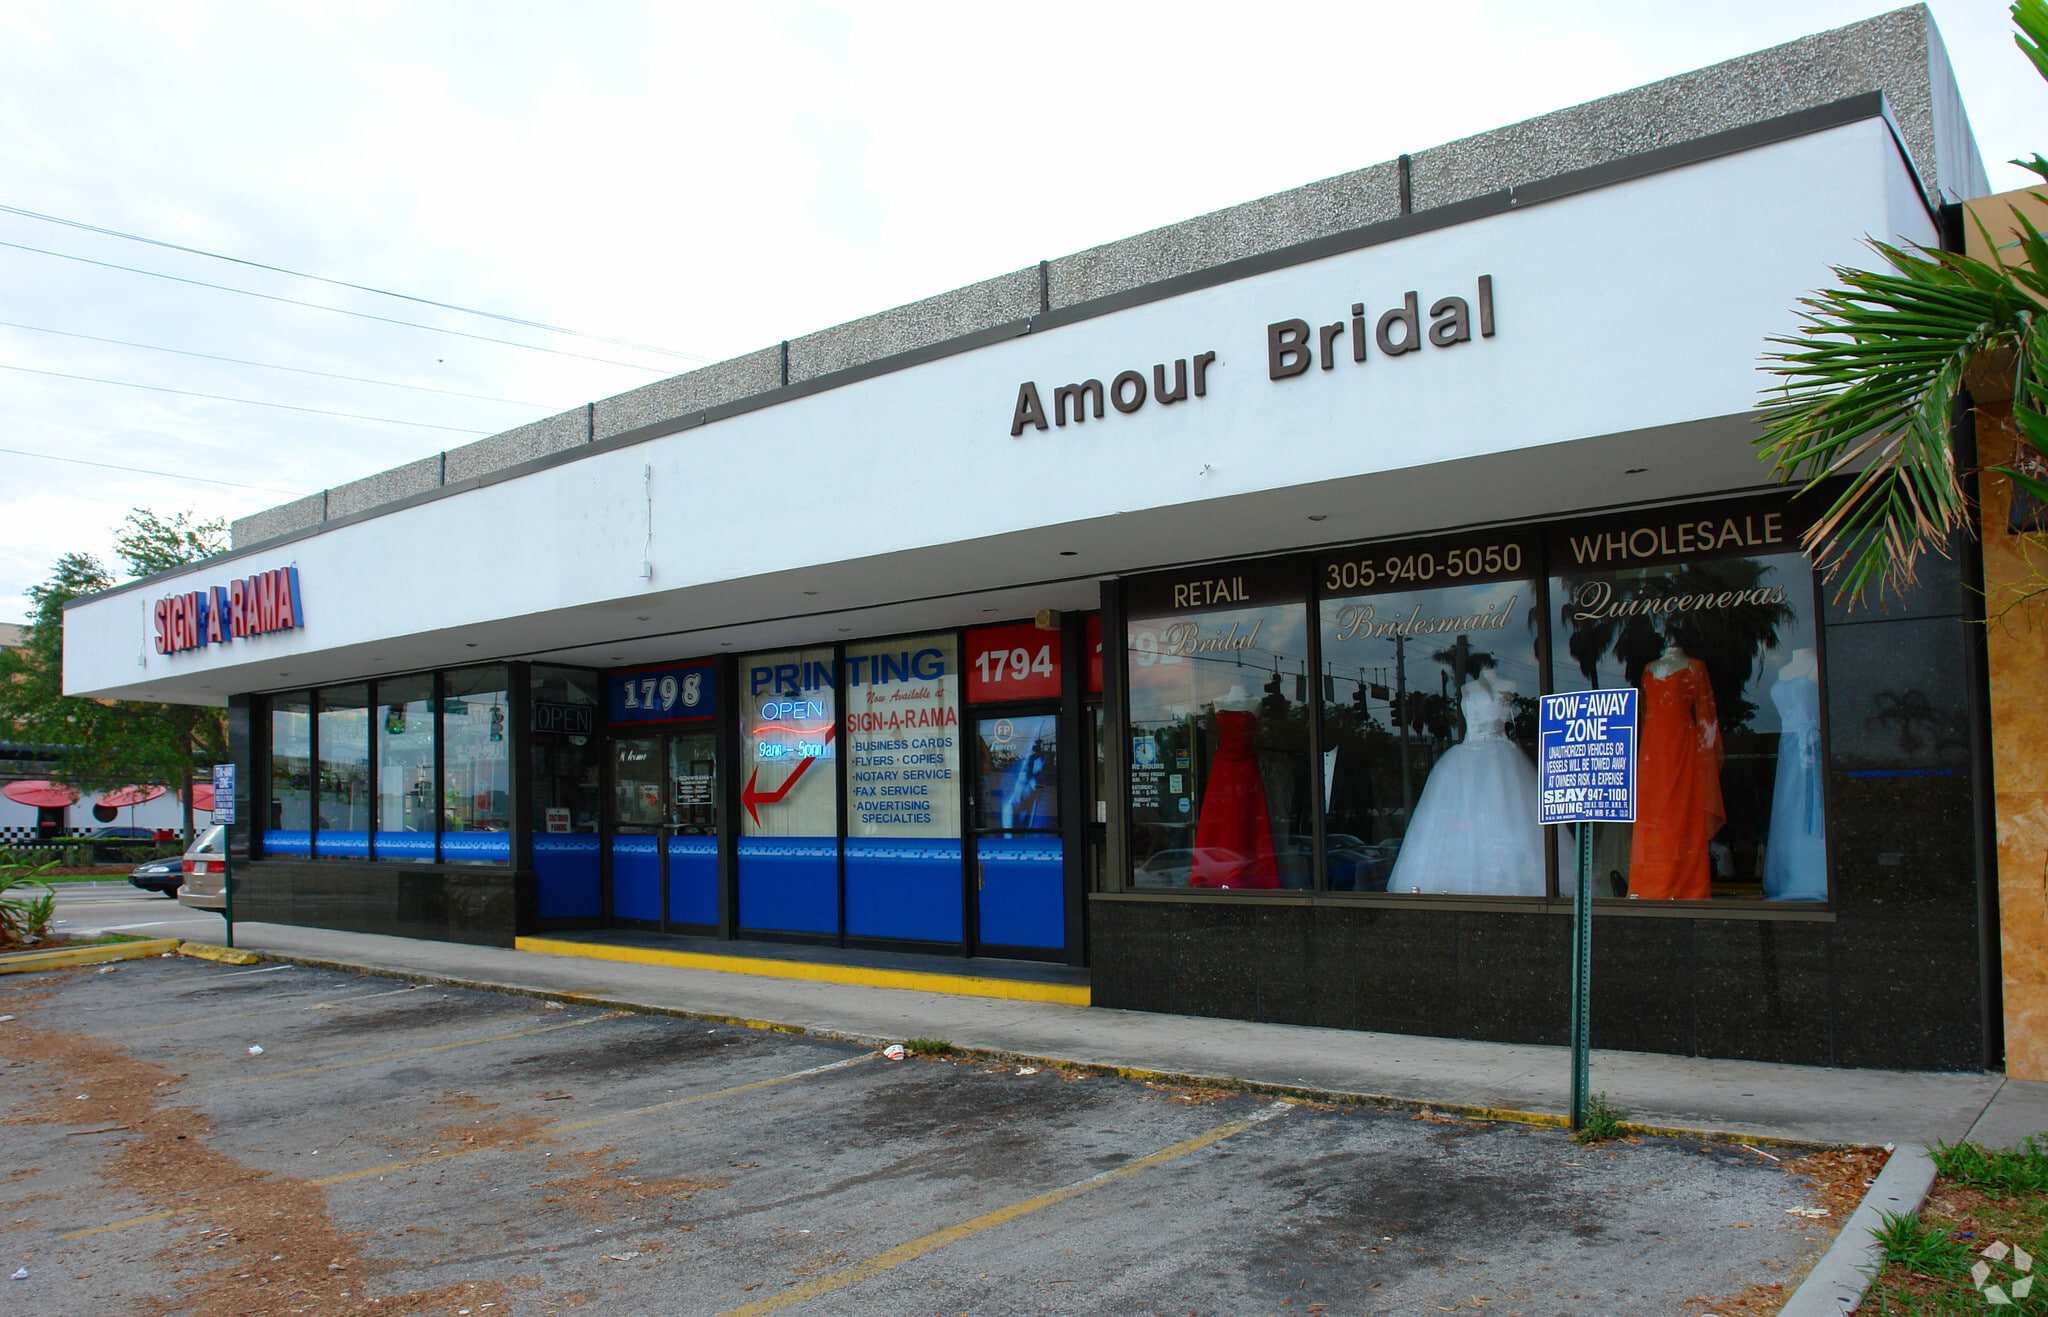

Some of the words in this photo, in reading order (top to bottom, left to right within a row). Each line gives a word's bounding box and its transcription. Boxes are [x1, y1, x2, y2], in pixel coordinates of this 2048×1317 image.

[1010, 350, 1216, 437] Amour
[1267, 274, 1496, 380] Bridal
[1570, 512, 1783, 564] WHOLESALE
[1326, 543, 1522, 590] 305-940-5050
[1174, 576, 1250, 608] RETAIL
[1574, 581, 1787, 621] Quinceneras
[1336, 595, 1518, 641] Bridesmaid
[1165, 619, 1264, 656] Bridal
[751, 648, 945, 696] PRINTING
[975, 645, 1053, 683] 1794
[624, 673, 702, 711] 1798
[866, 690, 885, 704] Now
[890, 687, 931, 702] Available
[935, 688, 945, 698] at
[538, 706, 588, 731] OPEN
[762, 701, 824, 721] OPEN
[1547, 693, 1629, 720] TOW-AWAY
[847, 706, 958, 733] SIGN-A-RAMA
[1565, 718, 1608, 742] ZONE
[855, 740, 908, 751] BUSINESS
[911, 737, 953, 749] CARDS
[1549, 744, 1586, 759] UNAUTHORIZED
[1588, 743, 1614, 756] VEHICLES
[1616, 743, 1624, 755] OR
[855, 756, 894, 766] FLYERS
[902, 754, 944, 764] COPIES
[1547, 760, 1568, 773] VESSELS
[1569, 759, 1580, 772] WILL
[1582, 758, 1589, 770] BE
[1591, 758, 1610, 771] TOWED
[1612, 757, 1626, 770] AWAY
[855, 771, 899, 781] NOTARY
[902, 769, 952, 780] SERVICE
[1548, 776, 1555, 788] AT
[1556, 774, 1576, 787] OWNERS
[1578, 773, 1590, 786] RISK
[1598, 772, 1624, 785] EXPENSE
[855, 787, 876, 796] FAX
[880, 785, 928, 796] SERVICE
[1544, 788, 1587, 804] SEAY
[1587, 788, 1628, 801] 947-1100
[856, 800, 930, 811] ADVERTISING
[1544, 802, 1583, 815] TOWING
[861, 814, 931, 823] SPECIALTIES
